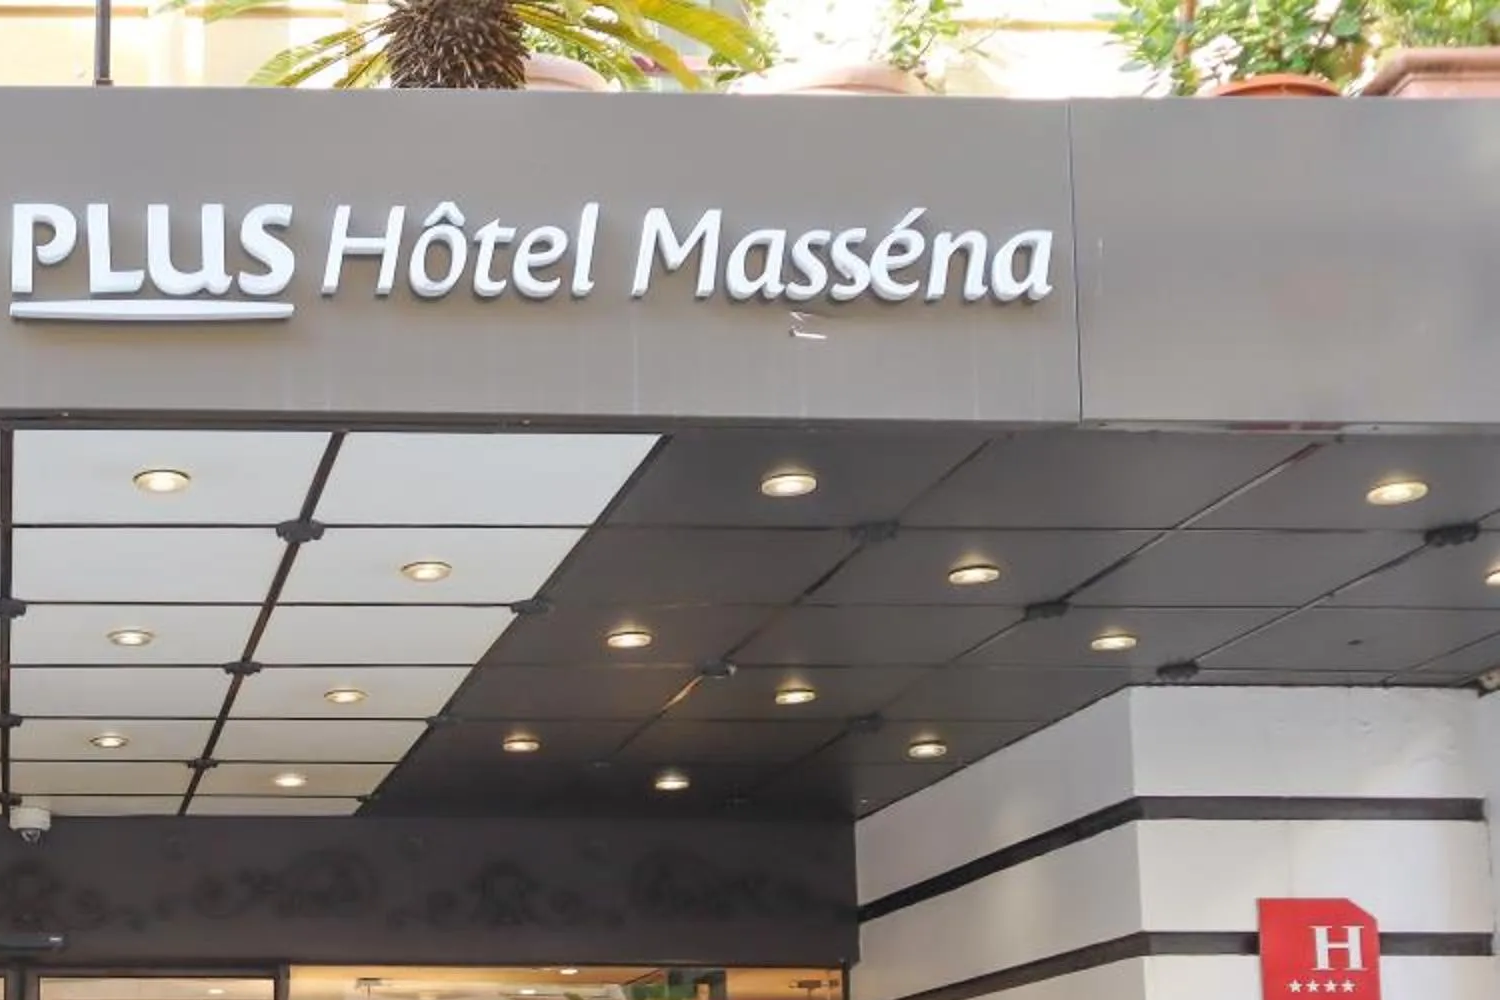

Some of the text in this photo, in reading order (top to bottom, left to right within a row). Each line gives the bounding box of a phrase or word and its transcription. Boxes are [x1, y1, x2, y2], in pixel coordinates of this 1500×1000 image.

[10, 202, 295, 297] PLUS
[321, 201, 600, 299] Hôtel
[631, 207, 1054, 302] Masséna
[1308, 925, 1368, 971] H
